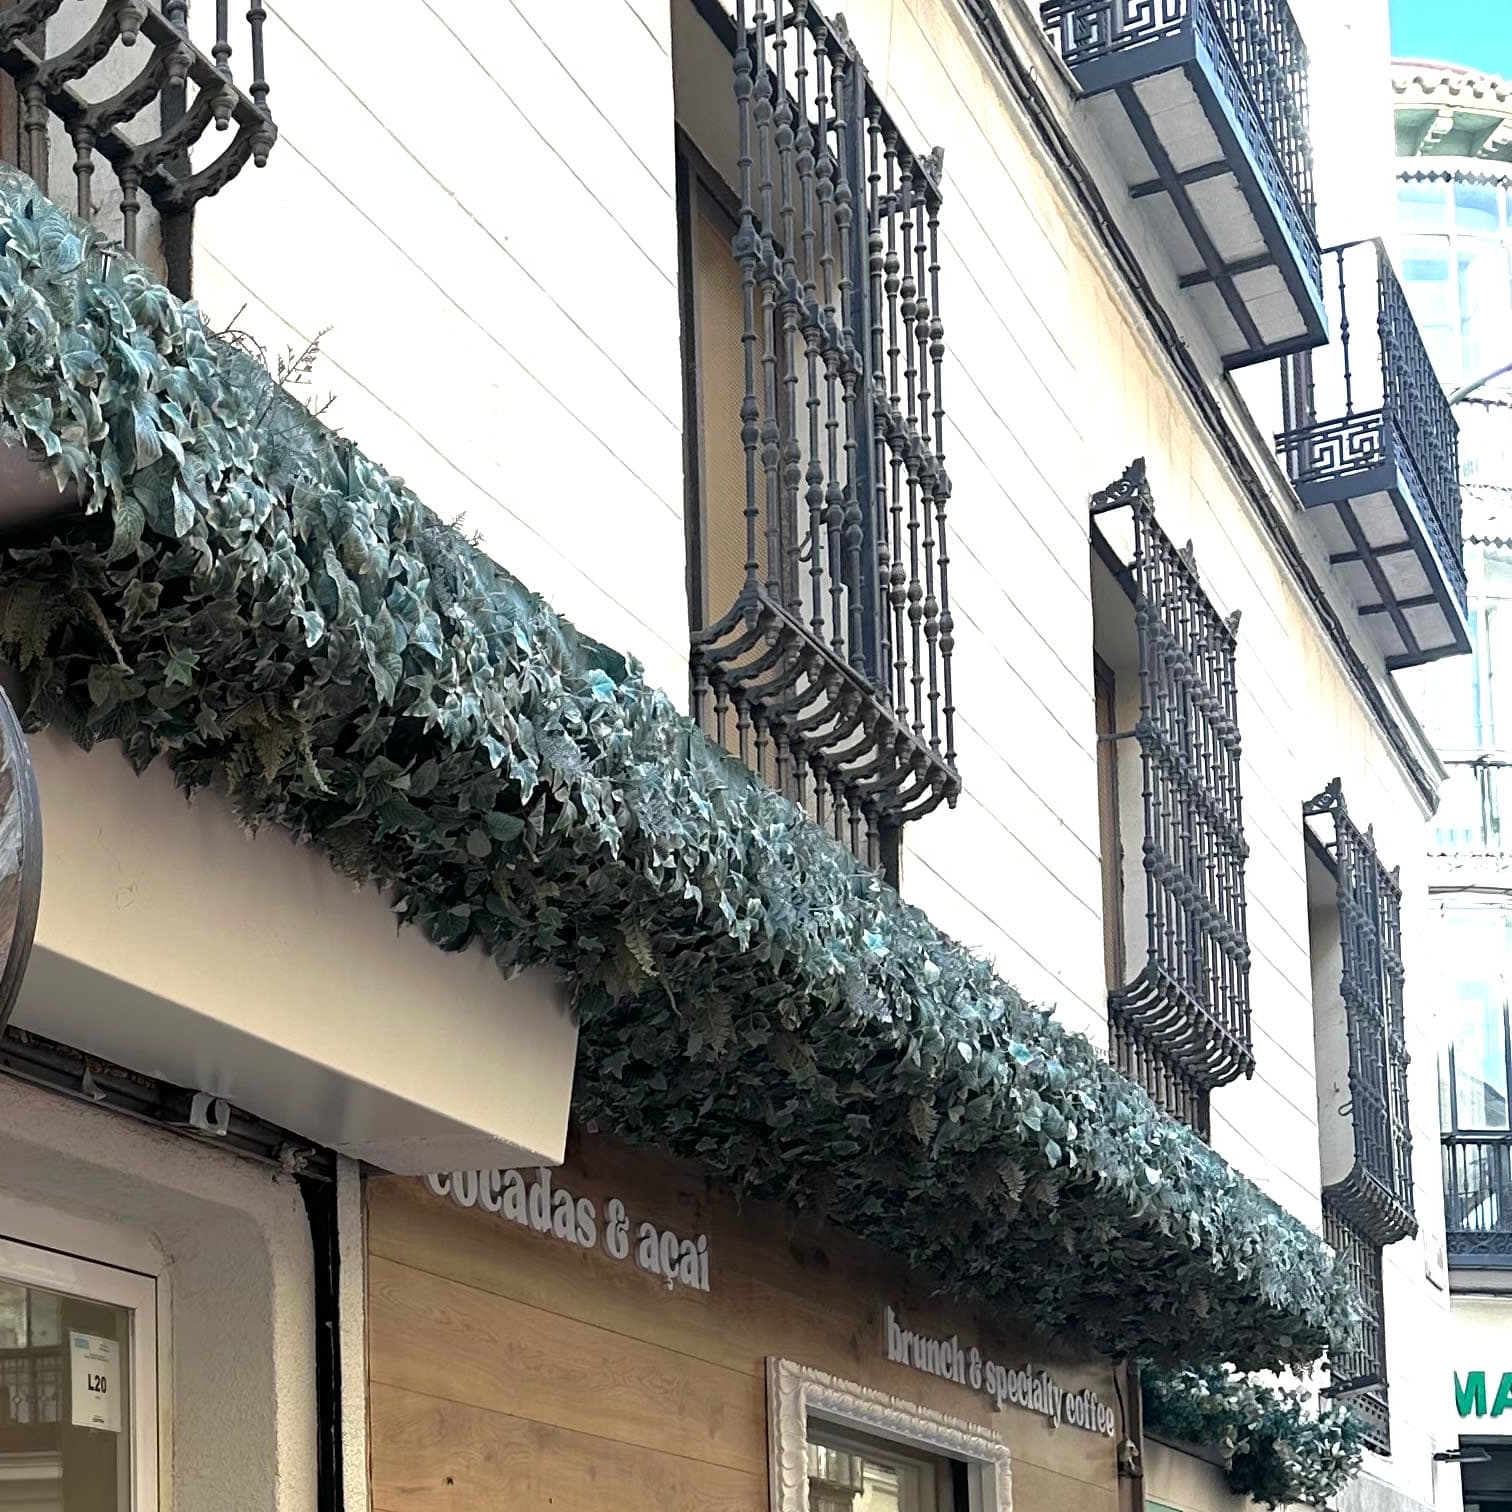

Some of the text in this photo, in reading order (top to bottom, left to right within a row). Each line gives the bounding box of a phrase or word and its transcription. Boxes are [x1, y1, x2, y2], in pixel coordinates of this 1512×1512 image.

[605, 1197, 630, 1260] &
[87, 1373, 107, 1394] L20
[885, 1304, 1116, 1438] brunch & specialty coffee
